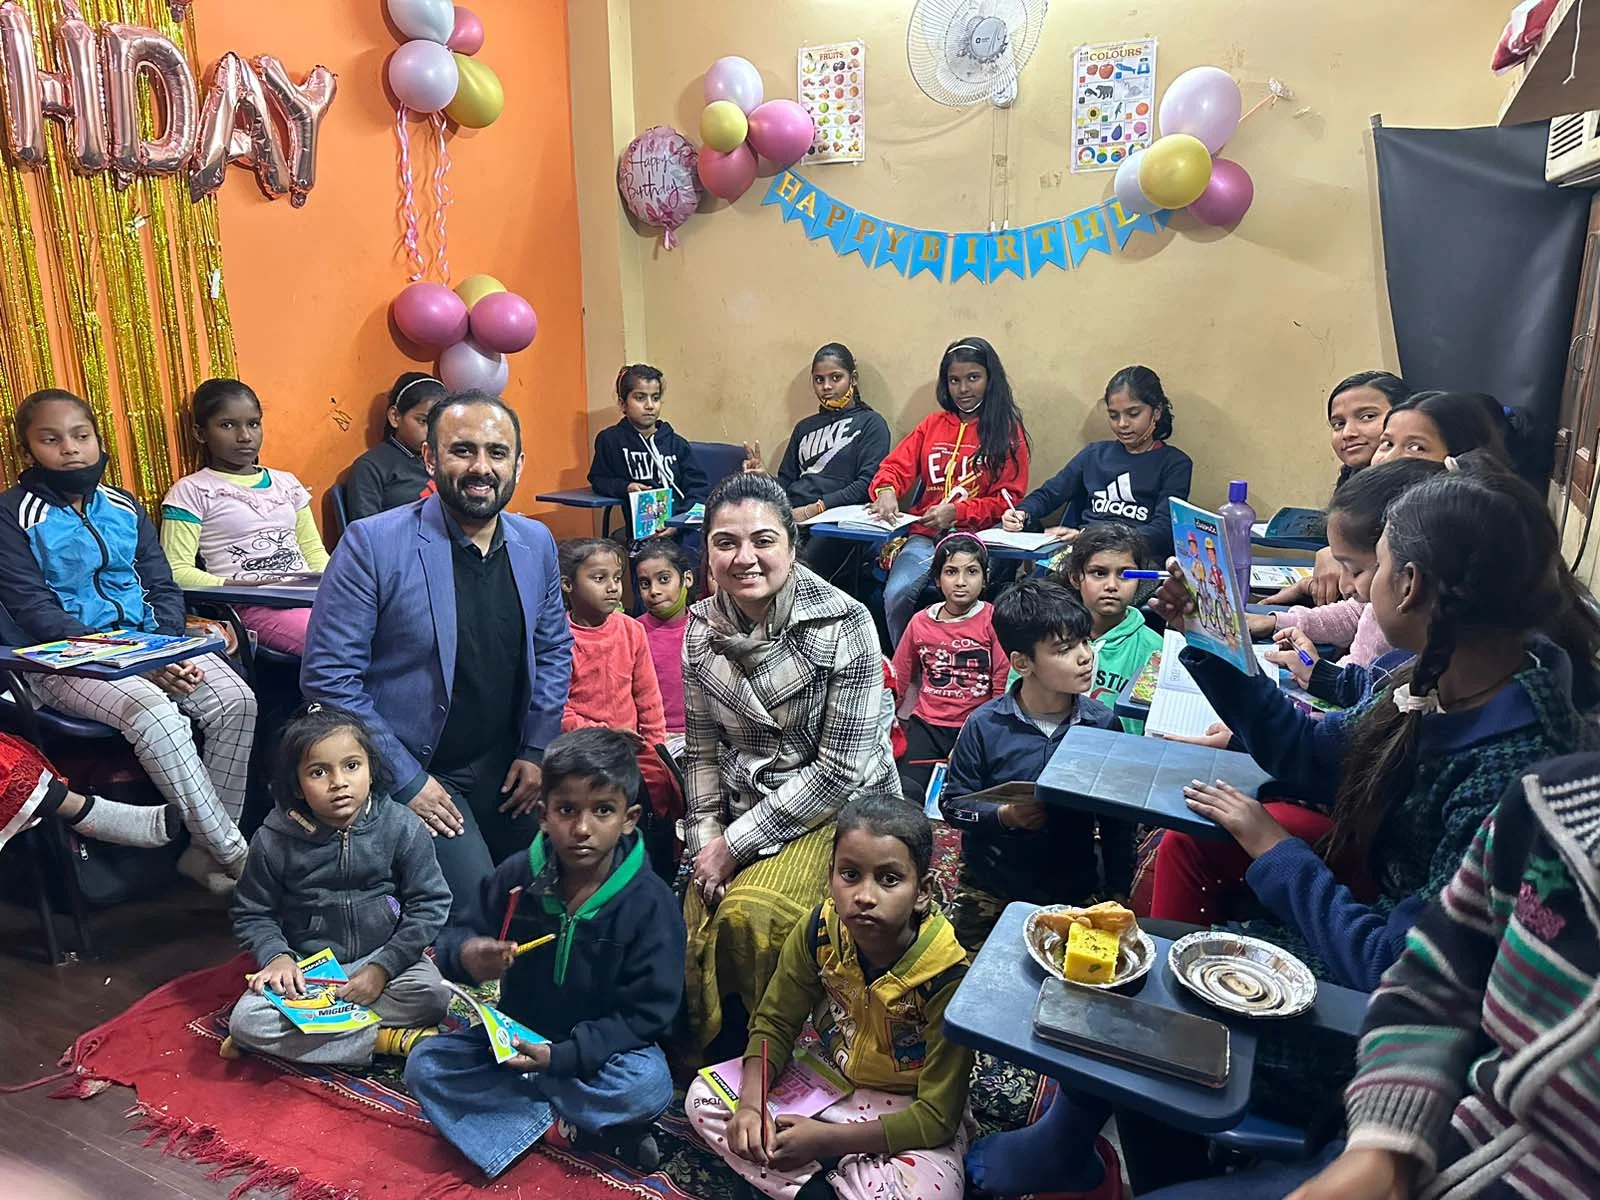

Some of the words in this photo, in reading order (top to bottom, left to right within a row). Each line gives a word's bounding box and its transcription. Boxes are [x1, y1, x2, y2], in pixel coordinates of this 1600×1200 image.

[819, 51, 844, 61] FRUITS
[1090, 47, 1142, 61] COLOURS
[628, 144, 676, 177] Happy
[625, 170, 679, 208] Birthday
[799, 417, 854, 464] NIKE
[1092, 498, 1149, 521] didas
[318, 1004, 357, 1016] MIGUEL
